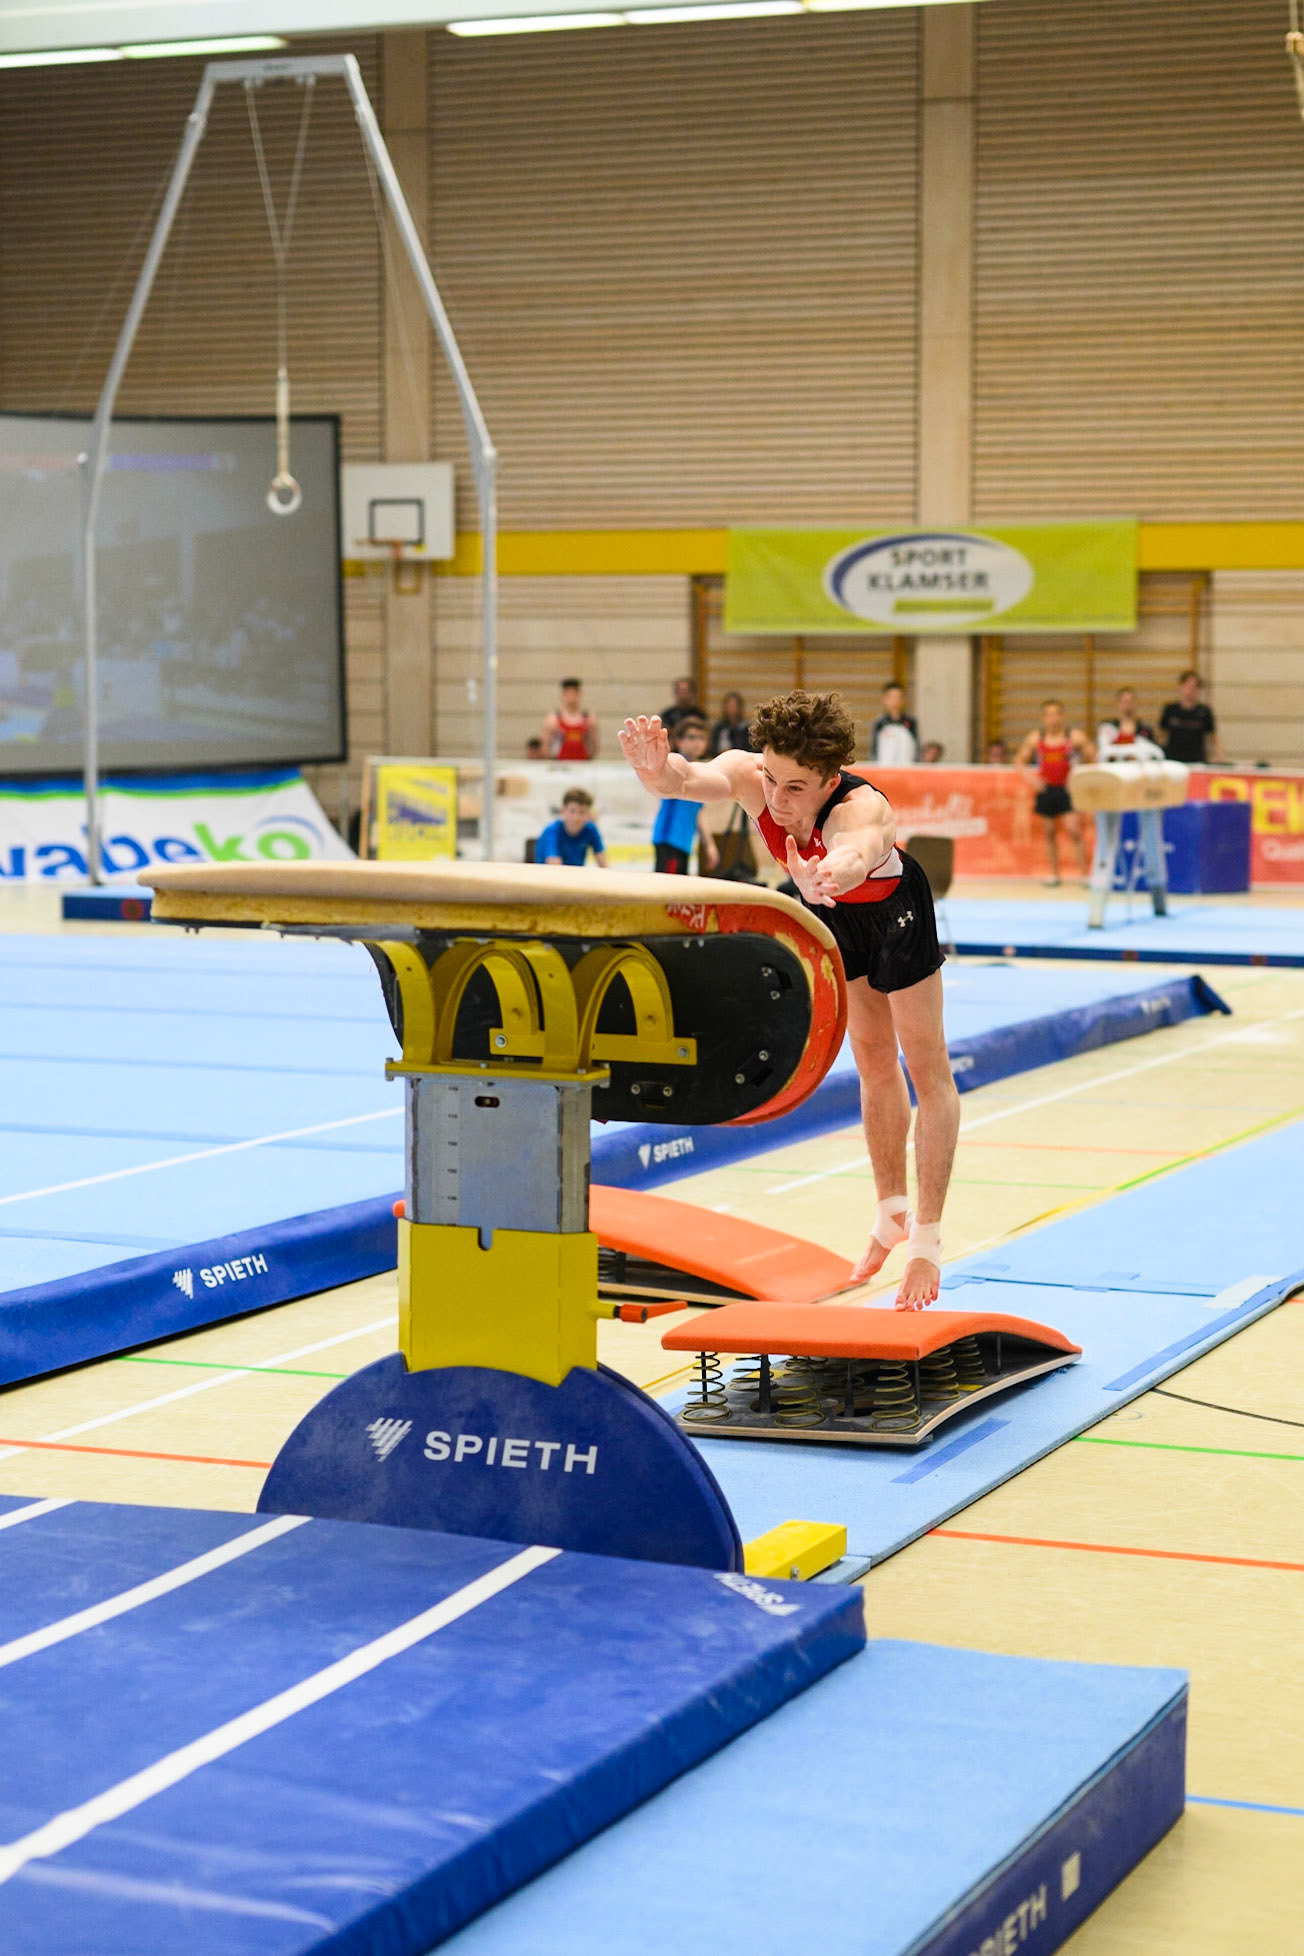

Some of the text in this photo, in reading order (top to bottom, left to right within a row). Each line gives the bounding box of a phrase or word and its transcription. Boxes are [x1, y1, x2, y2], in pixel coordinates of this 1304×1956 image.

[890, 547, 967, 567] SPORT
[867, 570, 989, 592] KLAMSER
[653, 1136, 694, 1163] SPIETH
[199, 1253, 268, 1288] SPIETH
[423, 1430, 598, 1474] SPIETH
[968, 1882, 1047, 1956] PIETH
